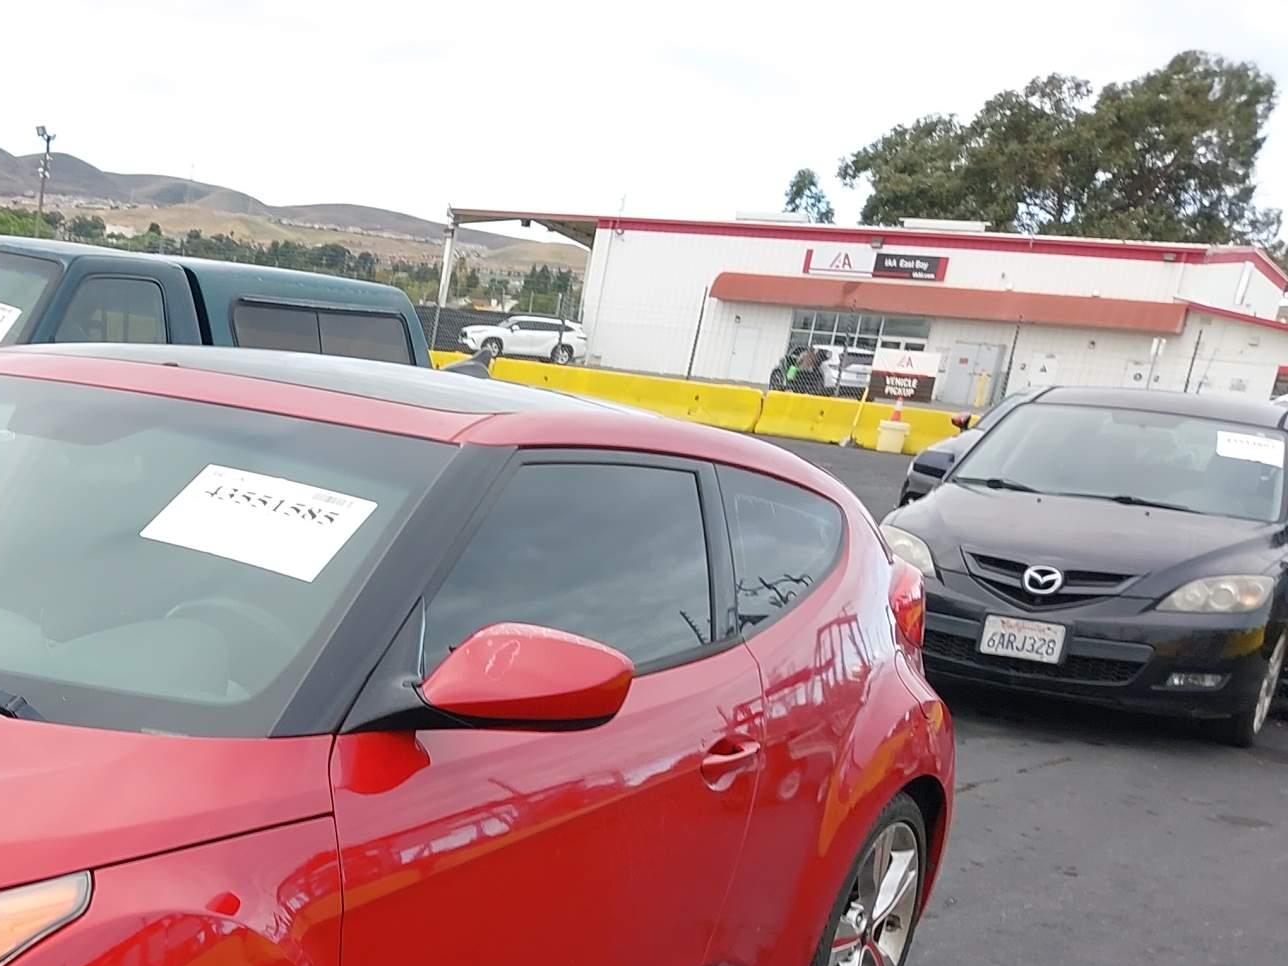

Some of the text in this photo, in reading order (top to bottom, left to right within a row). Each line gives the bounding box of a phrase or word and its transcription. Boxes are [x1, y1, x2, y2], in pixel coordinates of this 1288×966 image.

[915, 259, 929, 271] Bay
[885, 375, 918, 389] VEHICLE
[884, 385, 916, 397] PICKUP
[204, 486, 339, 526] 43551585
[986, 631, 1057, 656] 6ARJ328
